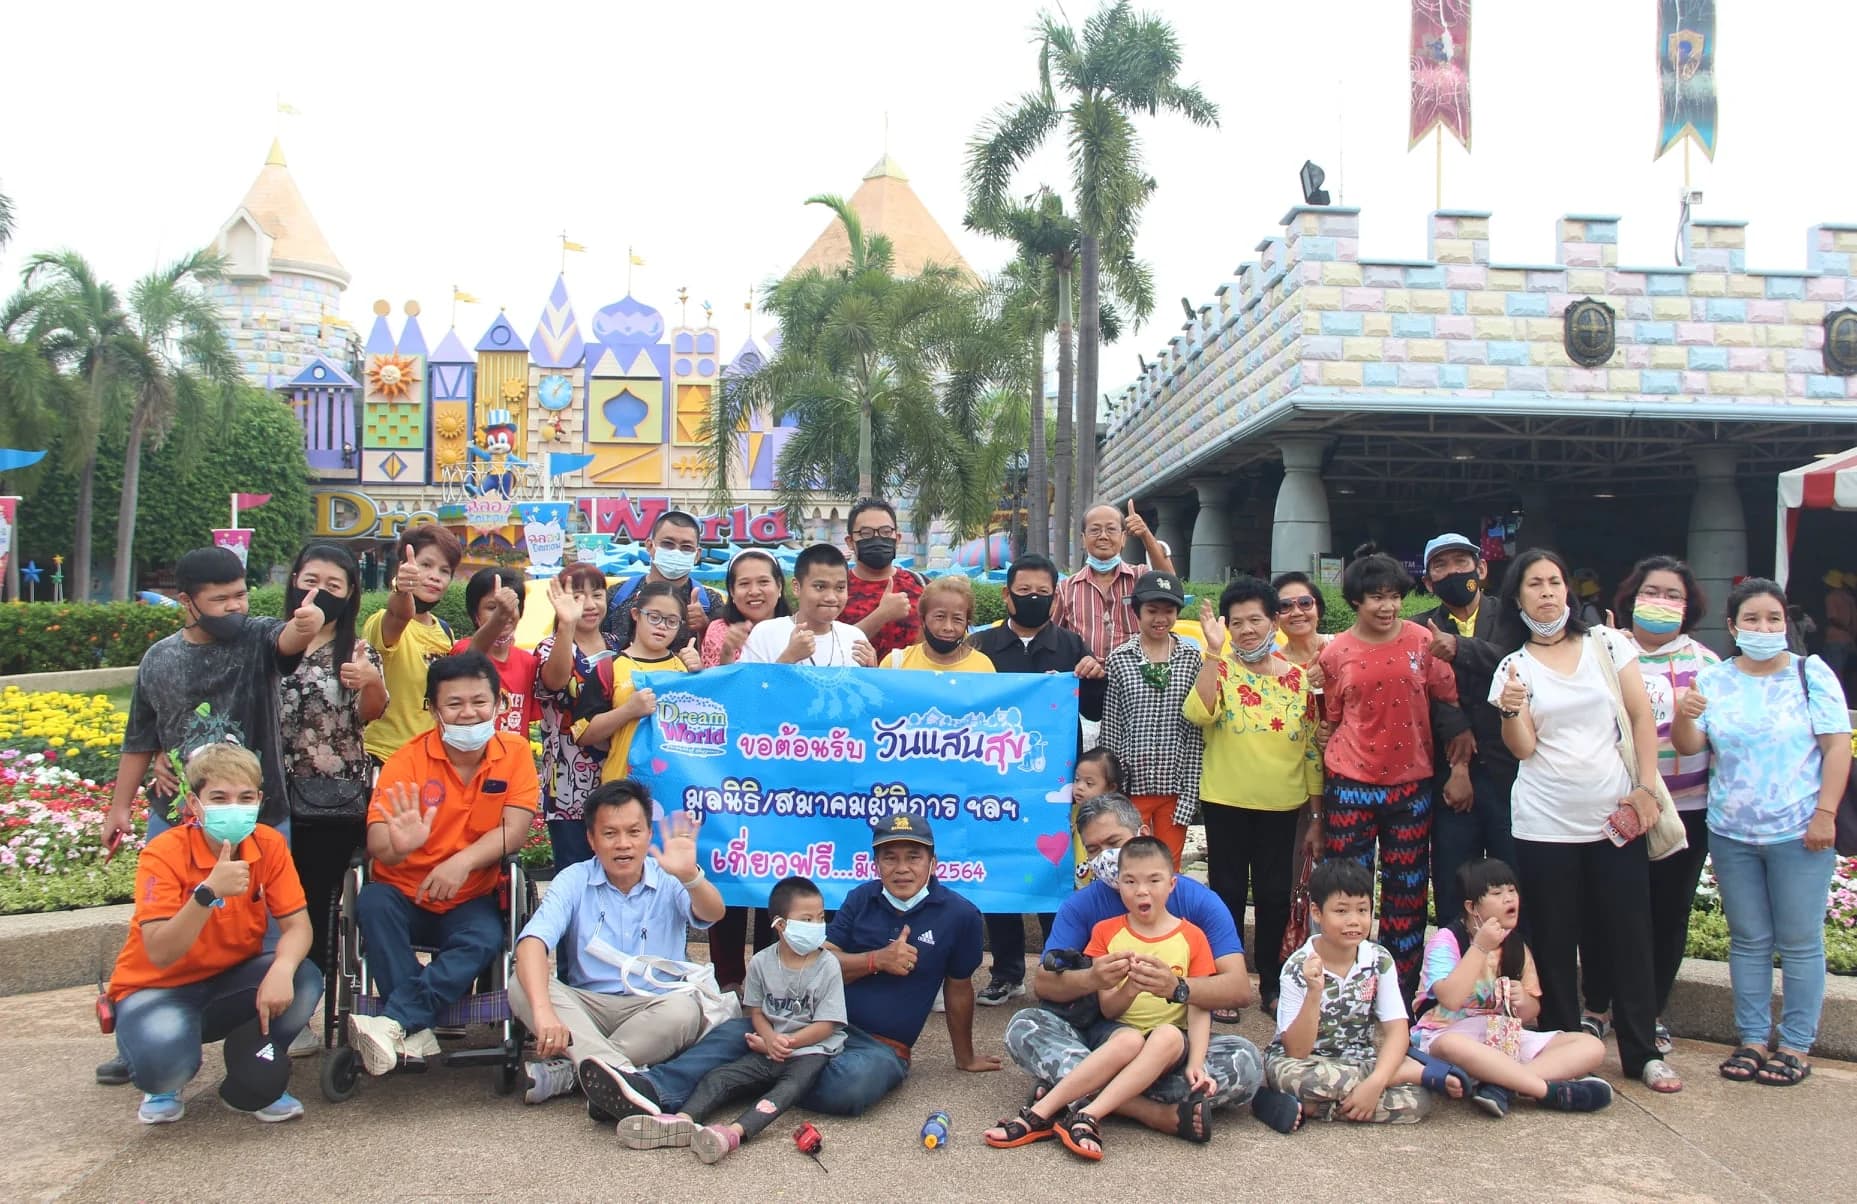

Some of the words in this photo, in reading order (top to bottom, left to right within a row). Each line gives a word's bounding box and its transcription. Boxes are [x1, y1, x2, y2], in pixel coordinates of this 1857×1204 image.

[577, 493, 794, 543] Wrld
[657, 701, 726, 726] Dream
[660, 722, 725, 745] World
[739, 724, 864, 760] ขอต้อนรับ
[874, 718, 1027, 773] วันแสนสุข
[966, 797, 1018, 819] ฯลฯ
[936, 862, 985, 881] 2564
